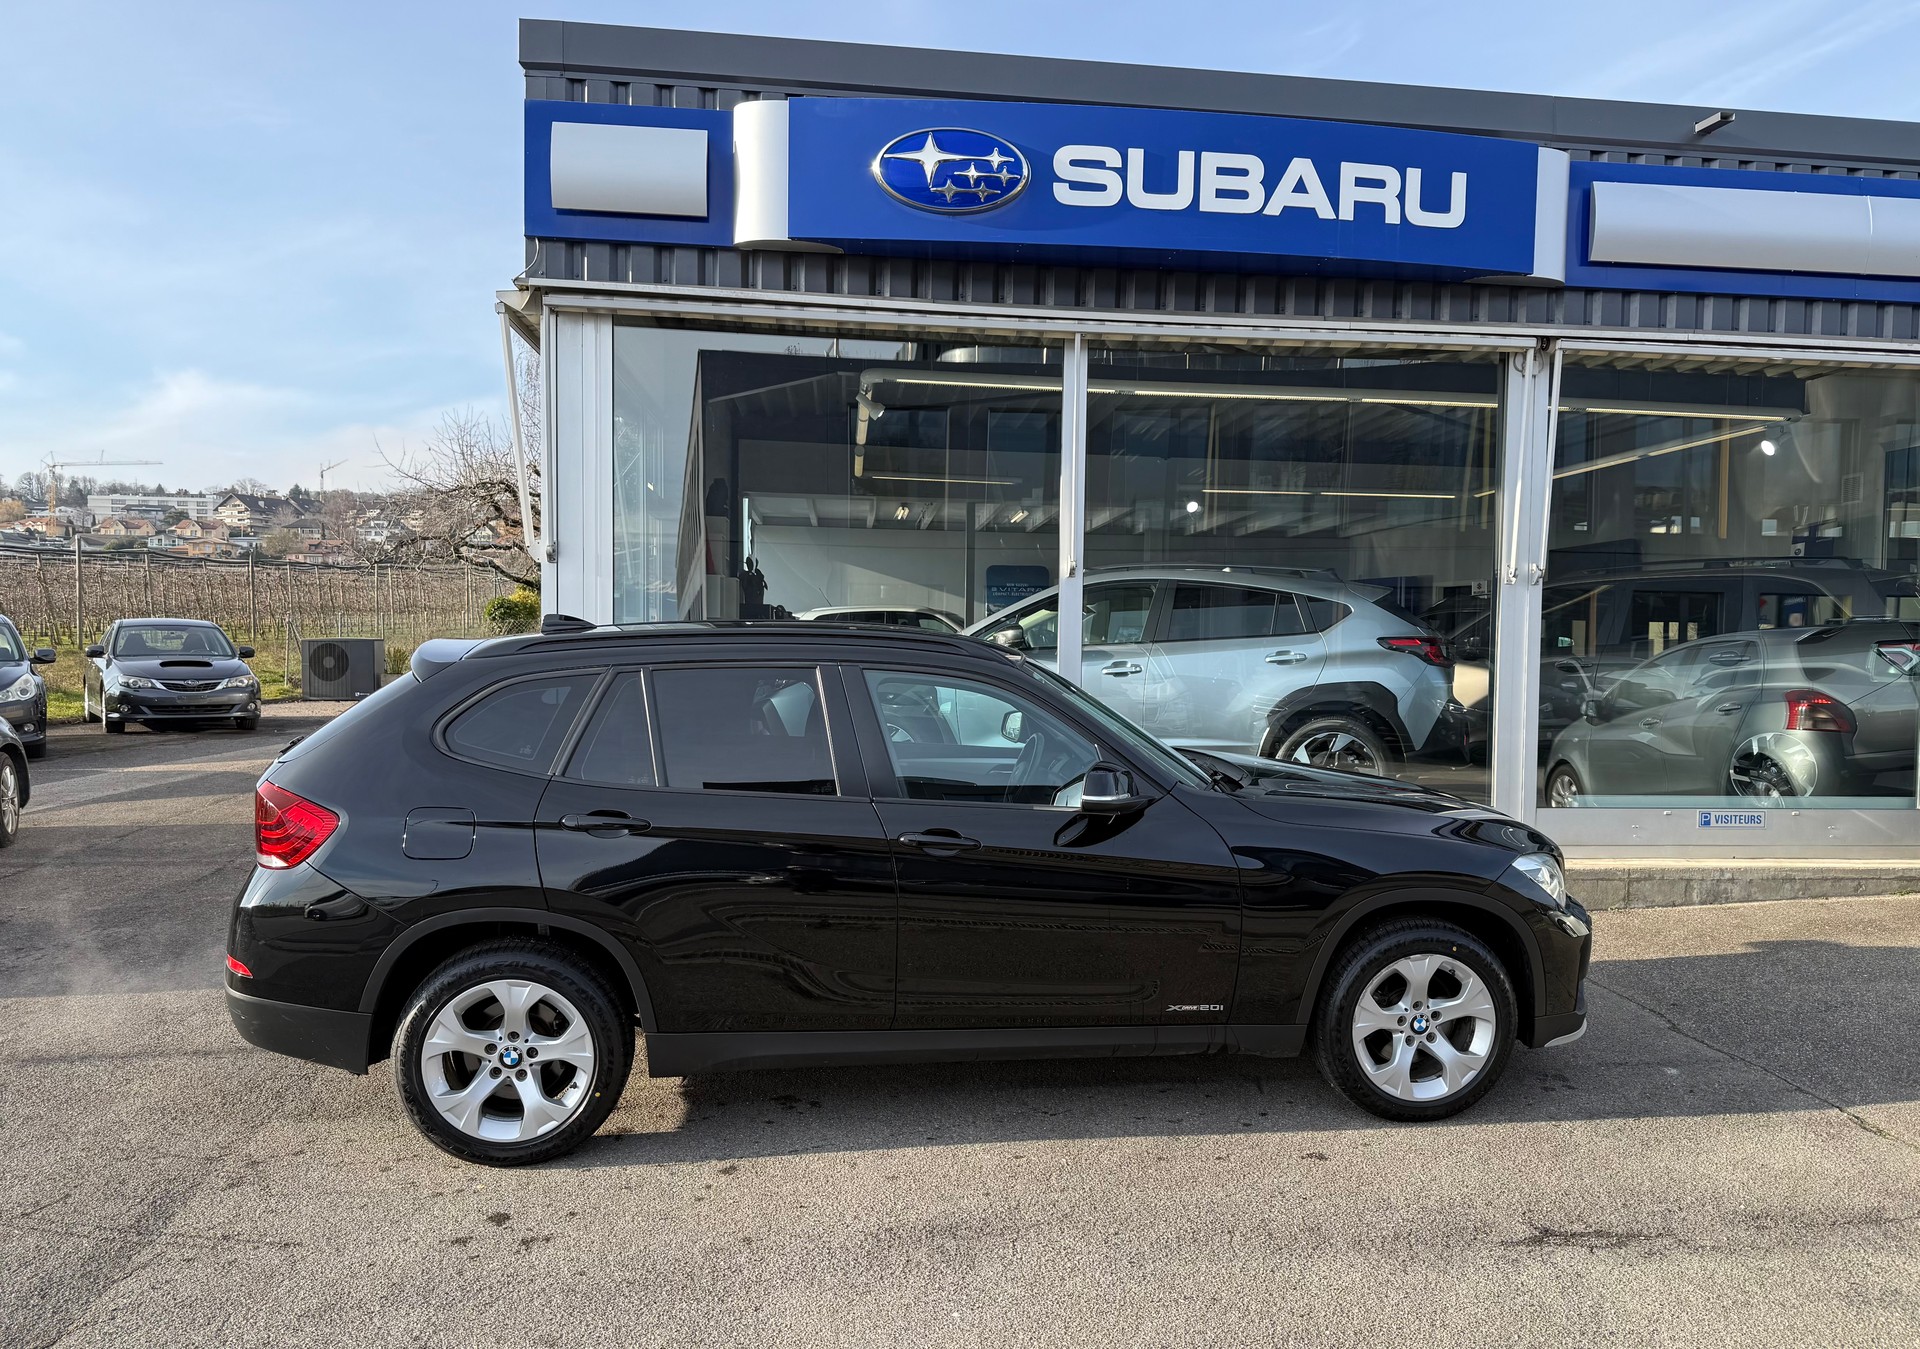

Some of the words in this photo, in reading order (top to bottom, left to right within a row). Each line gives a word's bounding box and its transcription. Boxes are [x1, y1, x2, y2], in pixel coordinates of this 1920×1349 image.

[1053, 145, 1467, 228] SUBARU
[1702, 814, 1710, 825] P
[1715, 814, 1762, 824] VISITEURS
